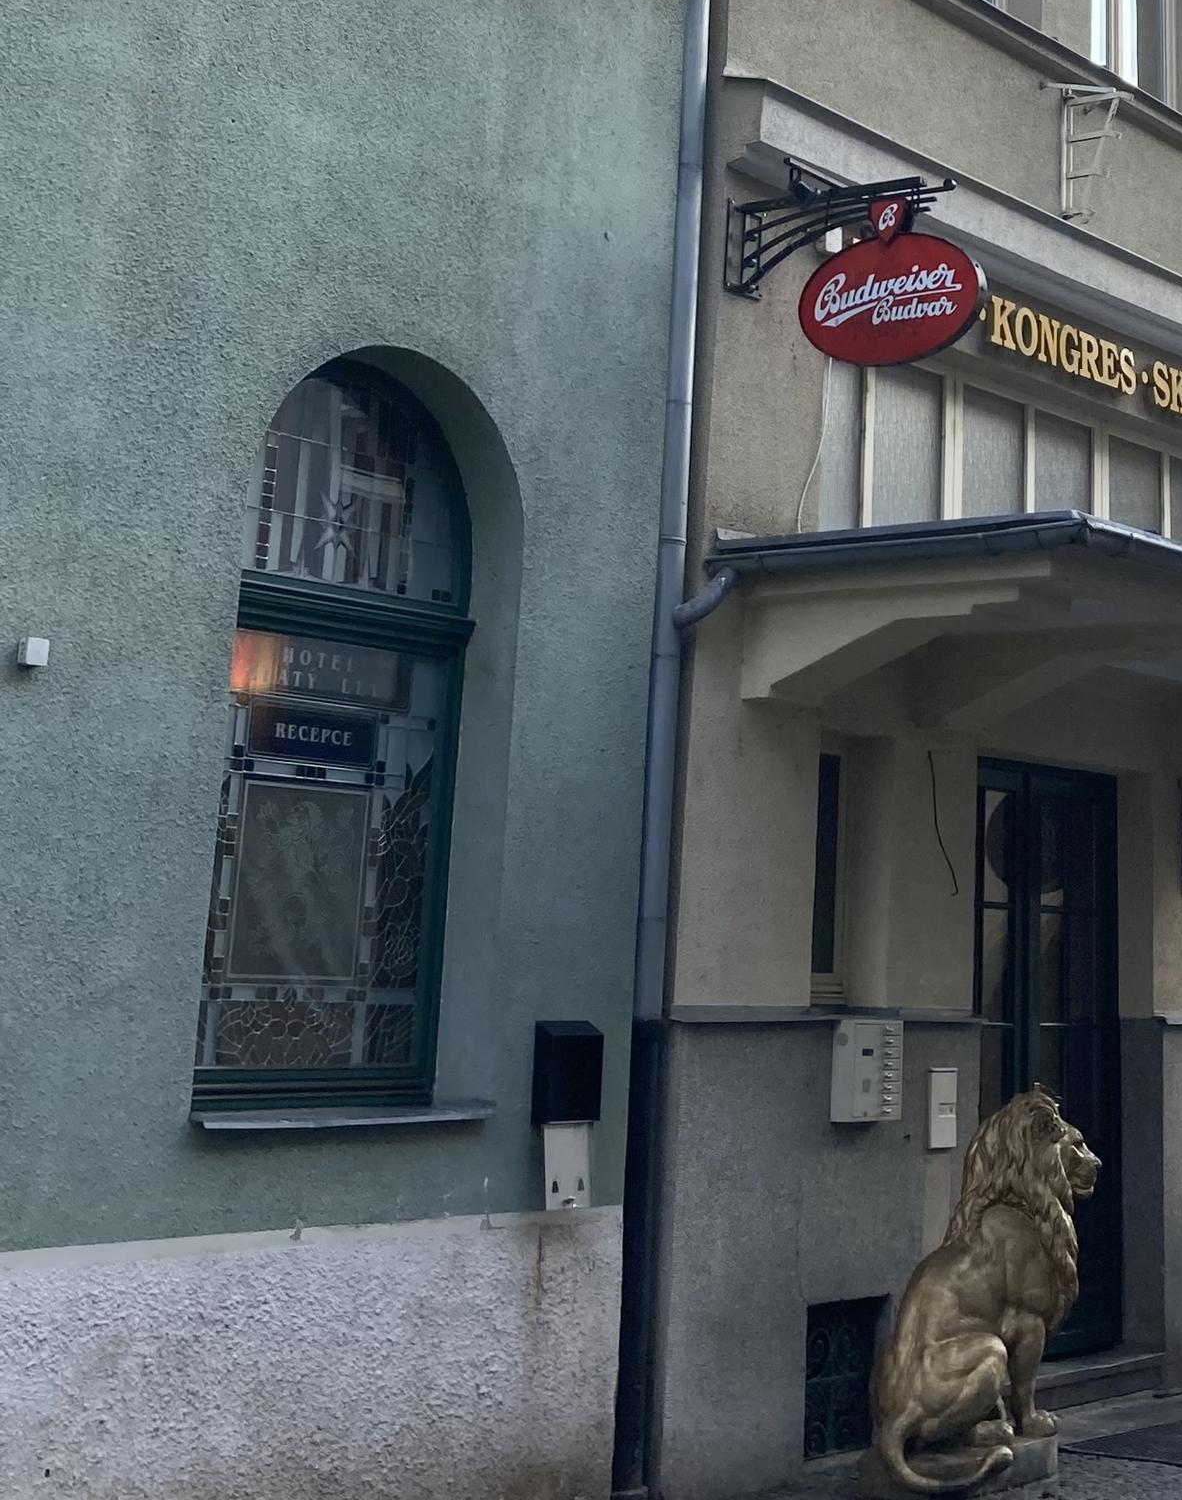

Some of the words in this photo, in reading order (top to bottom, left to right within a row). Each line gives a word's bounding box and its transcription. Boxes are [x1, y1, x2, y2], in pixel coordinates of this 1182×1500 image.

[814, 263, 962, 326] Budweiser
[872, 296, 957, 325] Budvar
[274, 722, 353, 747] RECEPCE
